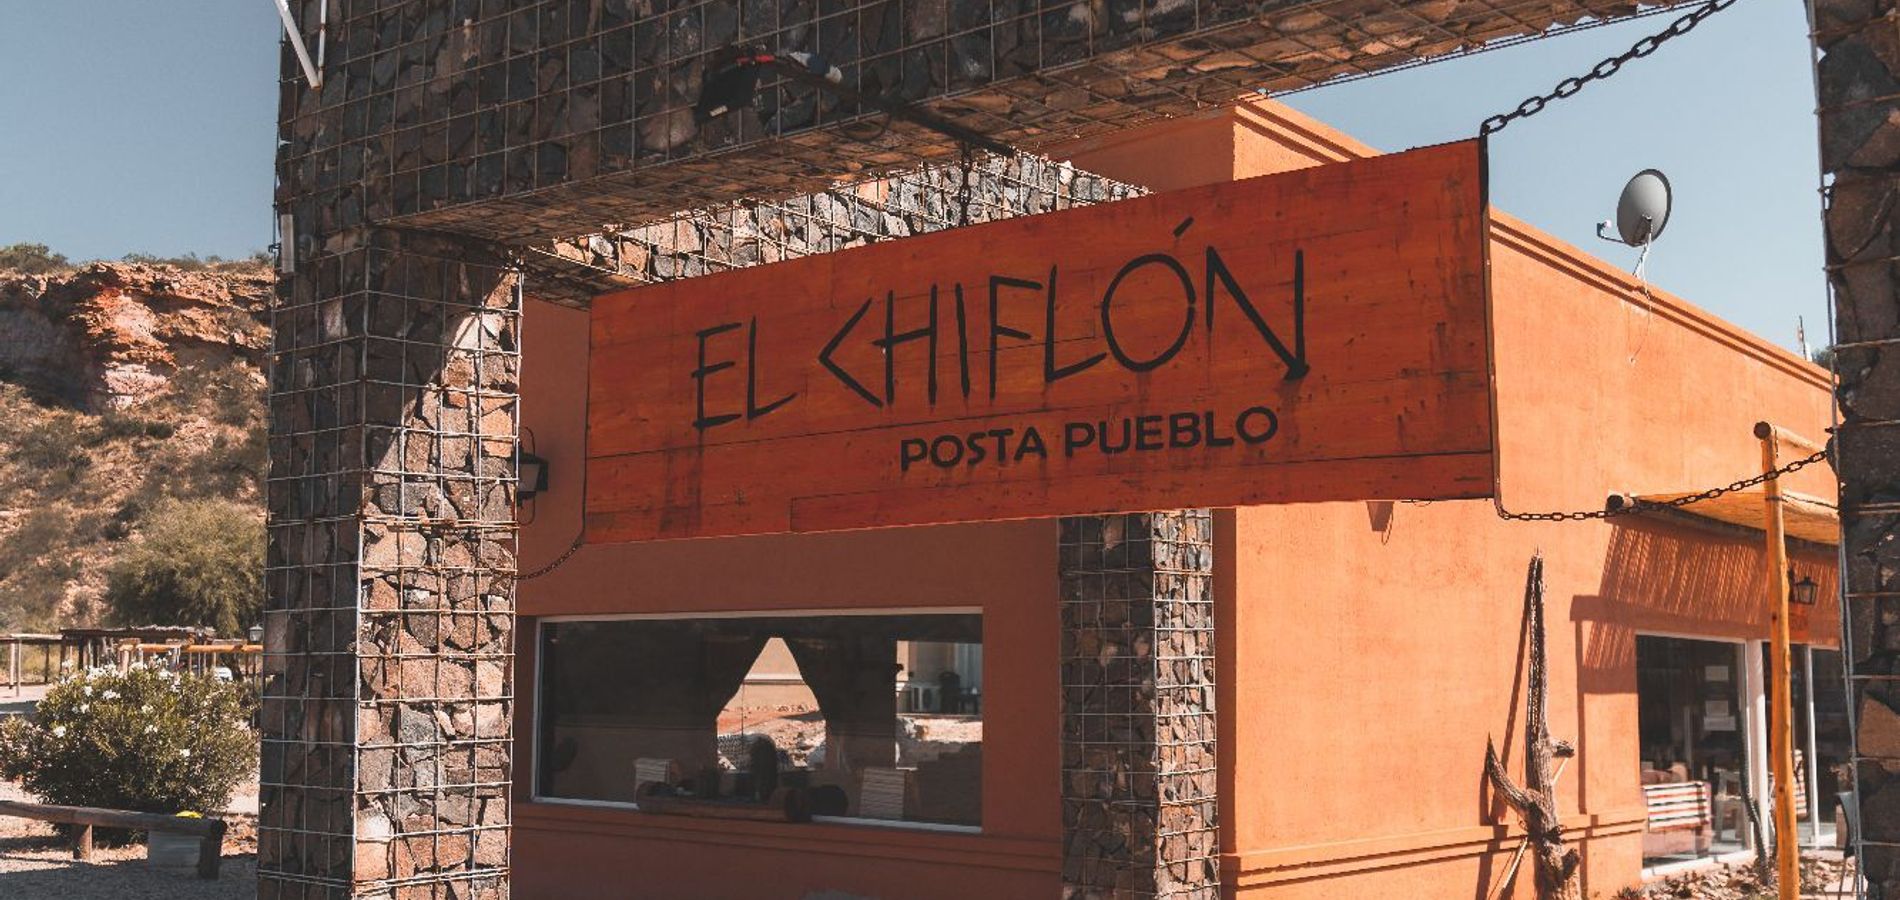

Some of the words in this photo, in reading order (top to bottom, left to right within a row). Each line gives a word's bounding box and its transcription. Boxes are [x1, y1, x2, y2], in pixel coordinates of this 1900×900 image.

[692, 317, 797, 429] EL
[818, 217, 1310, 408] CHIFLÓN
[900, 426, 1047, 473] POSTA
[1064, 405, 1279, 460] PUEBLO
